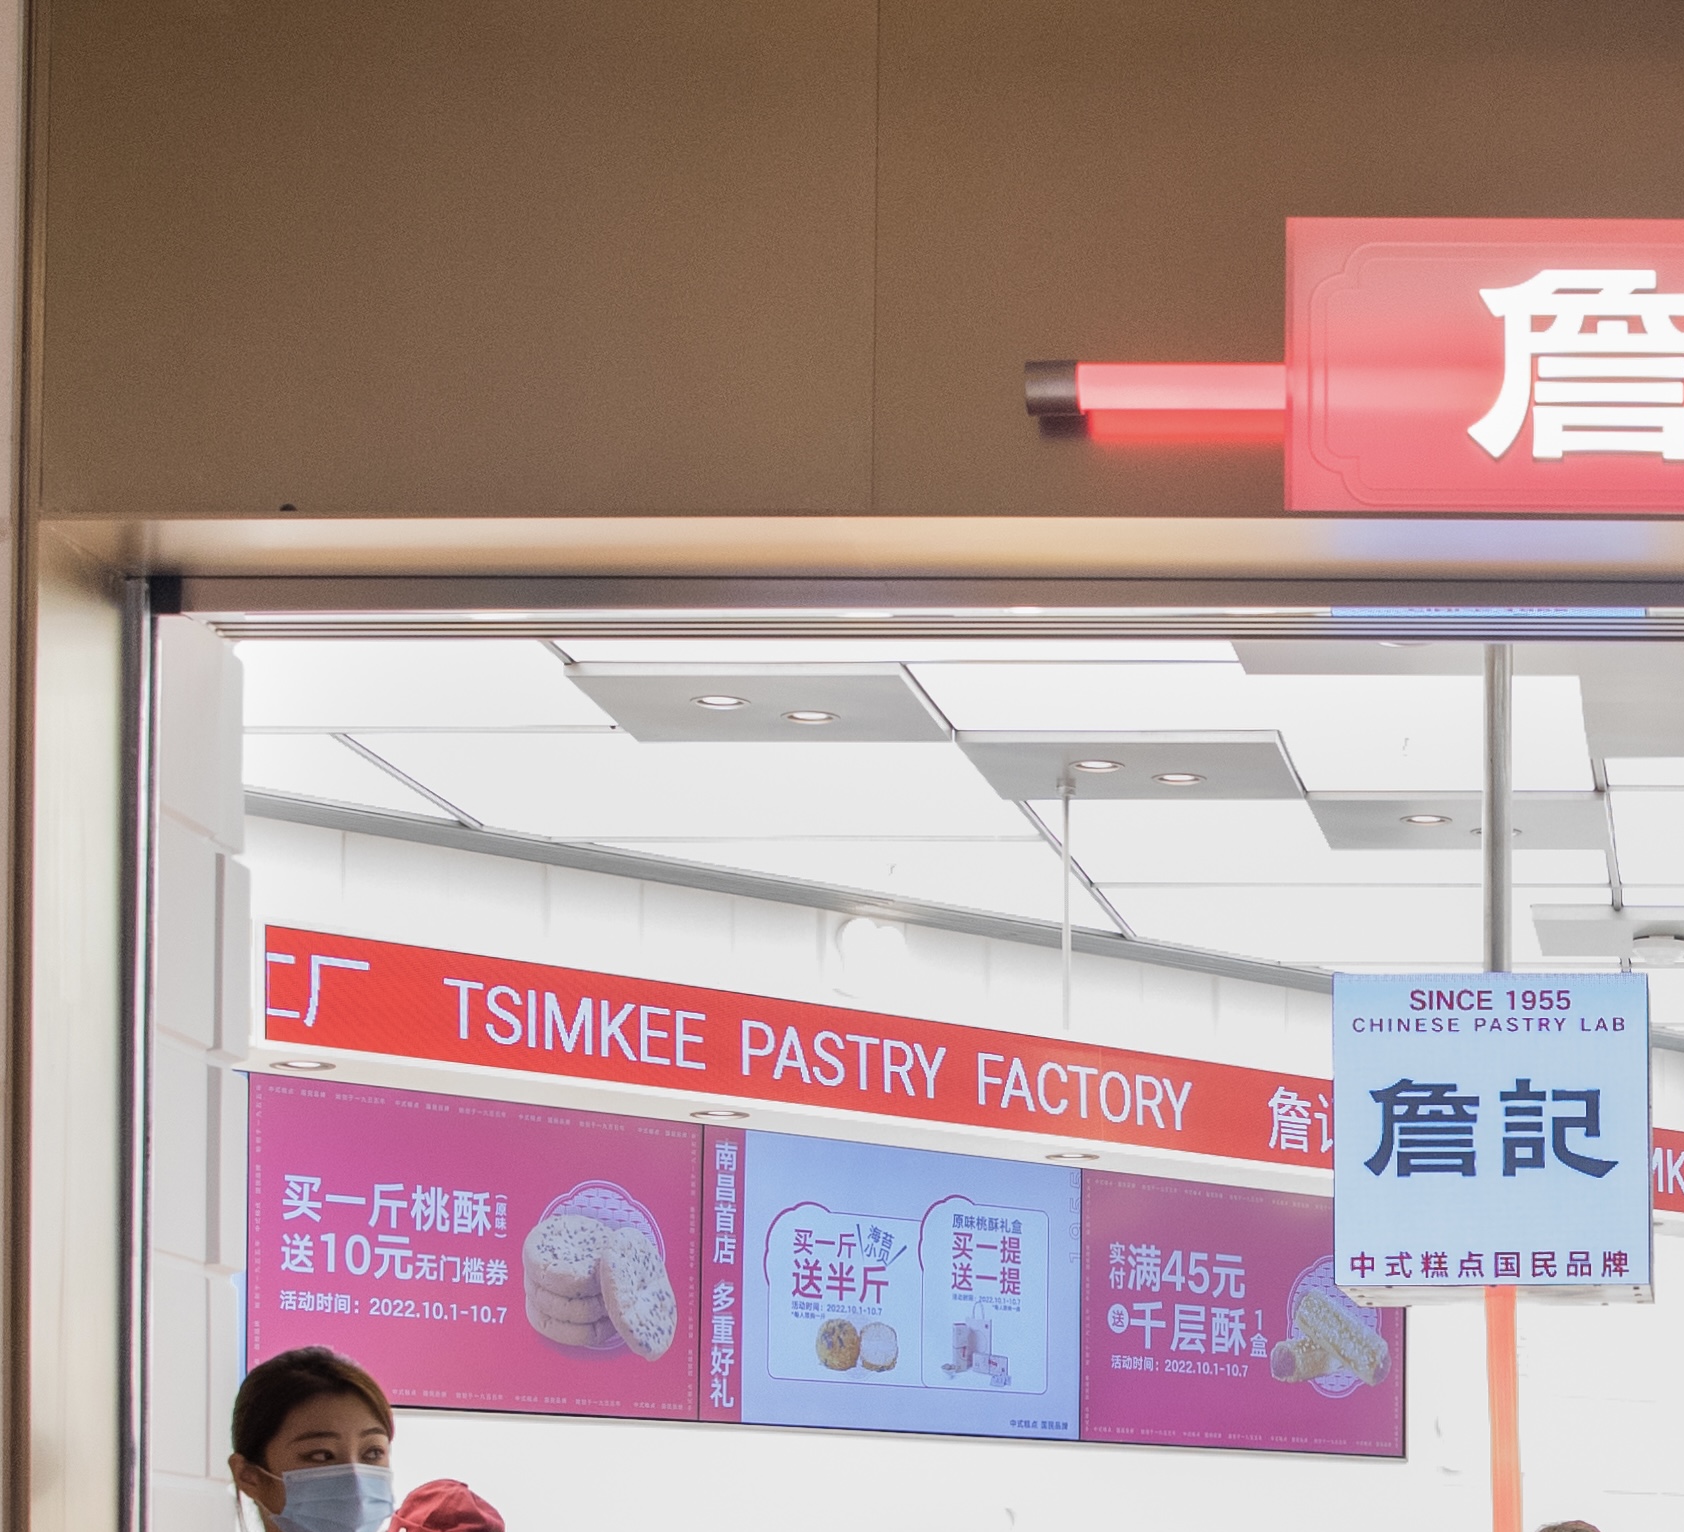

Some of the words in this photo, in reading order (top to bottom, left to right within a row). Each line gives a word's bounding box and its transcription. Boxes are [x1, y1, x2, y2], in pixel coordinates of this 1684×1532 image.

[1409, 989, 1493, 1011] SINCE
[1506, 989, 1571, 1010] 1955
[1352, 1017, 1460, 1033] CHINESE
[1474, 1017, 1566, 1033] PASTRY
[1580, 1017, 1626, 1033] LAB
[443, 977, 706, 1070] TSIMKEE
[741, 1019, 947, 1100] PASTRY
[976, 1052, 1192, 1132] FACTORY
[1363, 1078, 1619, 1178] 詹記
[282, 1174, 492, 1237] 买一斤桃酥
[713, 1138, 738, 1265] 南昌首店
[951, 1213, 1023, 1235] 原味桃酥礼盒
[793, 1228, 857, 1259] 买一斤
[951, 1231, 1022, 1265] 买一提
[1350, 1250, 1630, 1279] 中式糕点国民品牌
[791, 1257, 889, 1304] 送半斤
[951, 1262, 1021, 1296] 送一提
[1127, 1243, 1246, 1299] 满45元
[709, 1281, 735, 1409] 多重好礼
[1130, 1301, 1247, 1356] 千层酥
